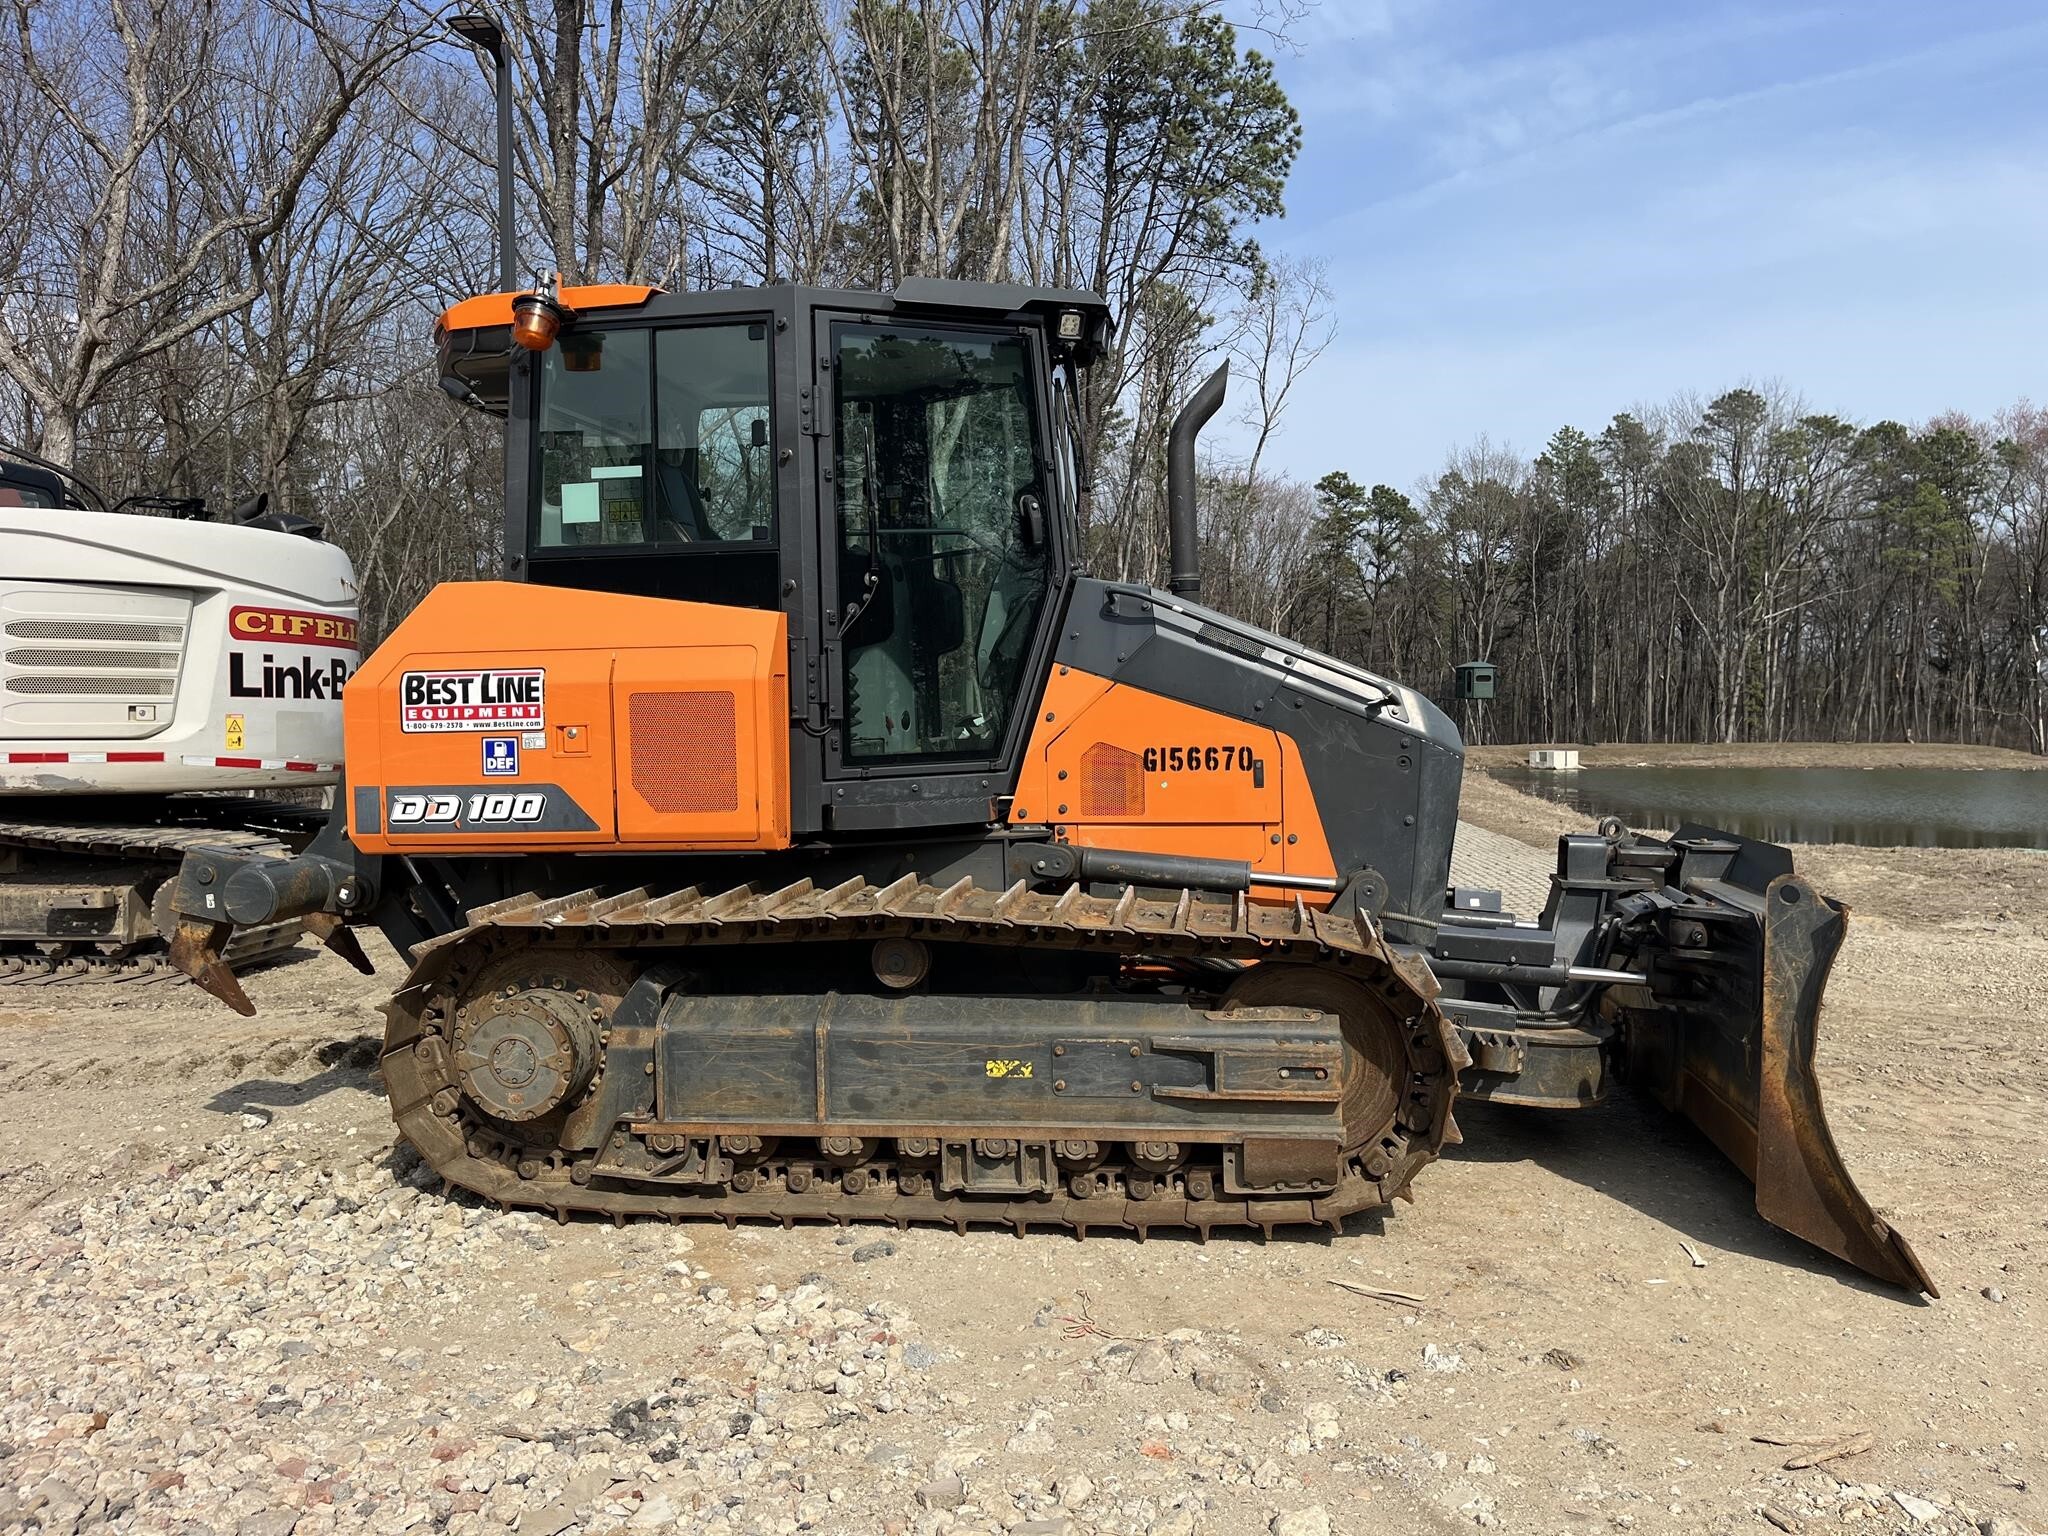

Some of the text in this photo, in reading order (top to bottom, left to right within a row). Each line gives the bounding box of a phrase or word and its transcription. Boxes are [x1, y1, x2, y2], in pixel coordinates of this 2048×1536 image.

[230, 652, 359, 700] Link-B
[405, 673, 540, 705] BEST LINE
[407, 706, 538, 719] EQUIPMENT
[473, 720, 541, 728] www.BestLine.com
[487, 758, 514, 769] DEF
[390, 793, 547, 824] DD 100
